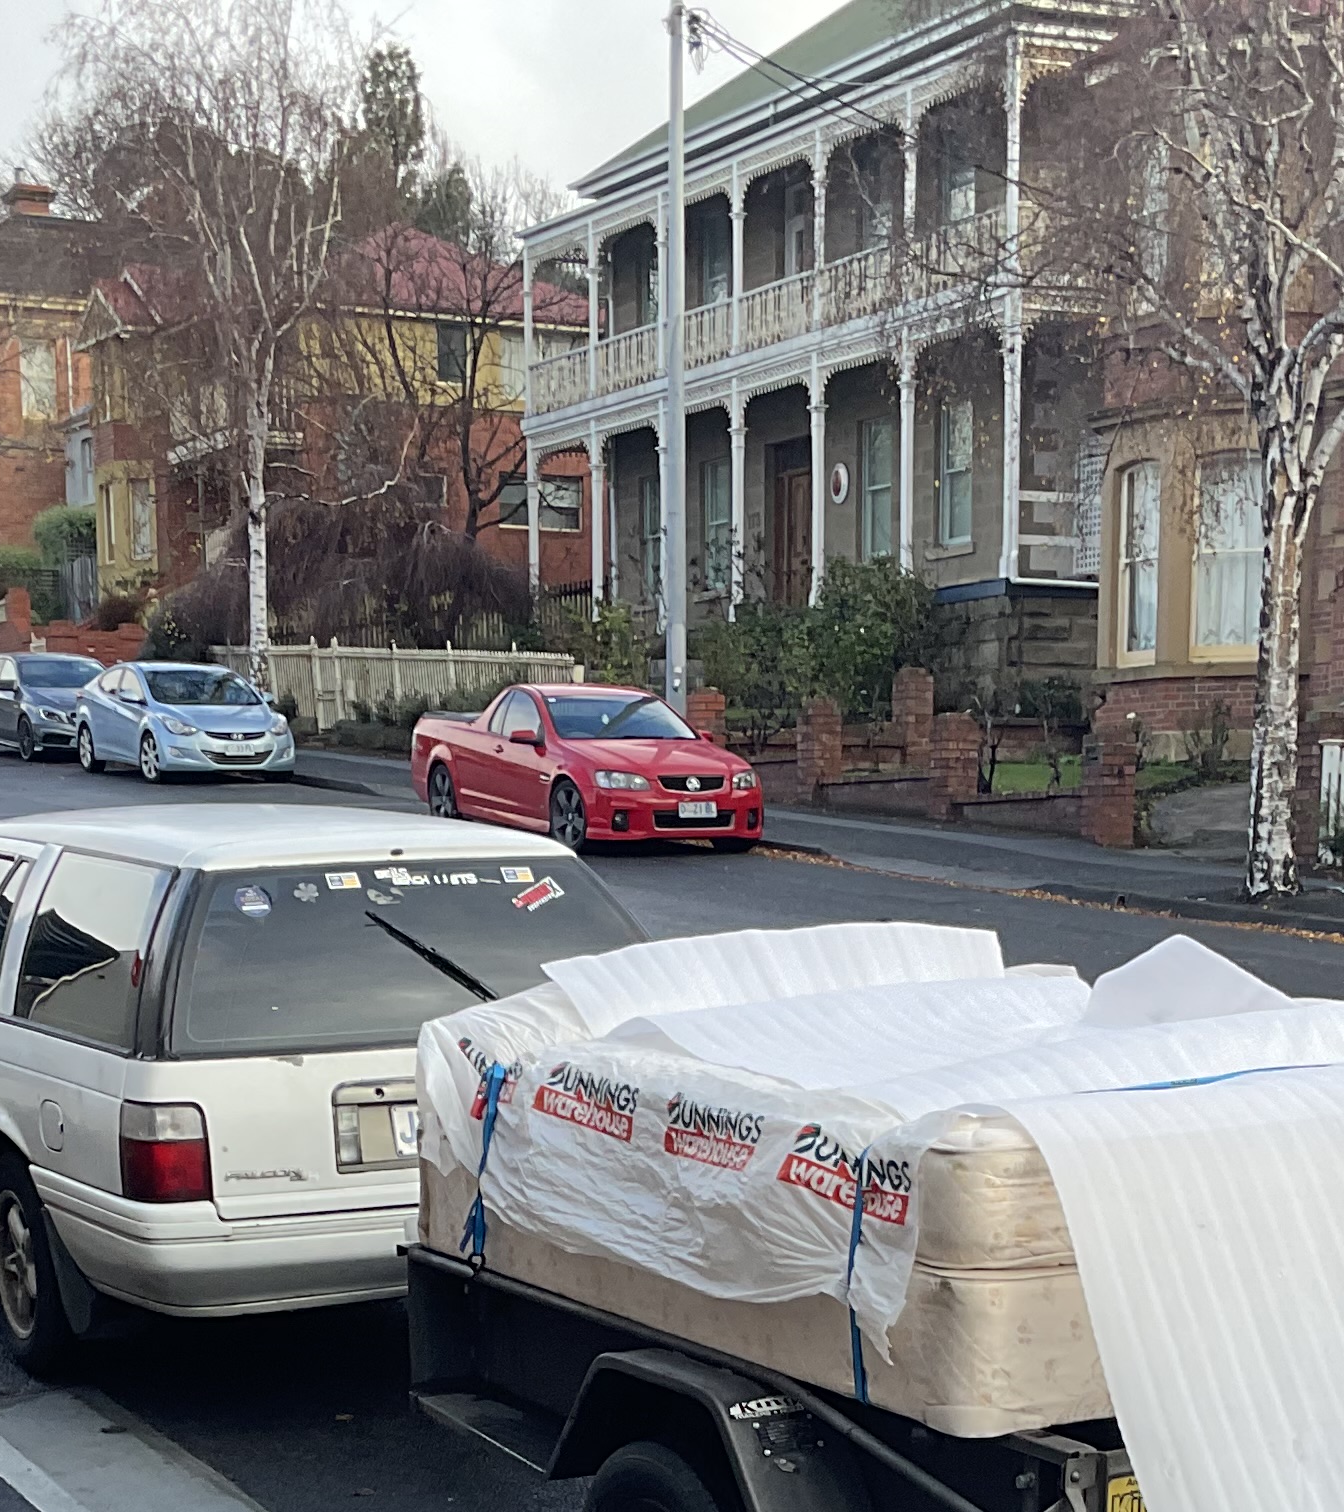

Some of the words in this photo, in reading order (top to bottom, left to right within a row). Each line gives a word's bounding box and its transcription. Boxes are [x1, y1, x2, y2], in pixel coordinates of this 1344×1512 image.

[542, 1088, 630, 1139] warehouse
[547, 1062, 639, 1115] BUNNINGS
[667, 1091, 765, 1144] BUNNINGS
[672, 1131, 749, 1169] warehouse
[789, 1158, 903, 1220] wareouse
